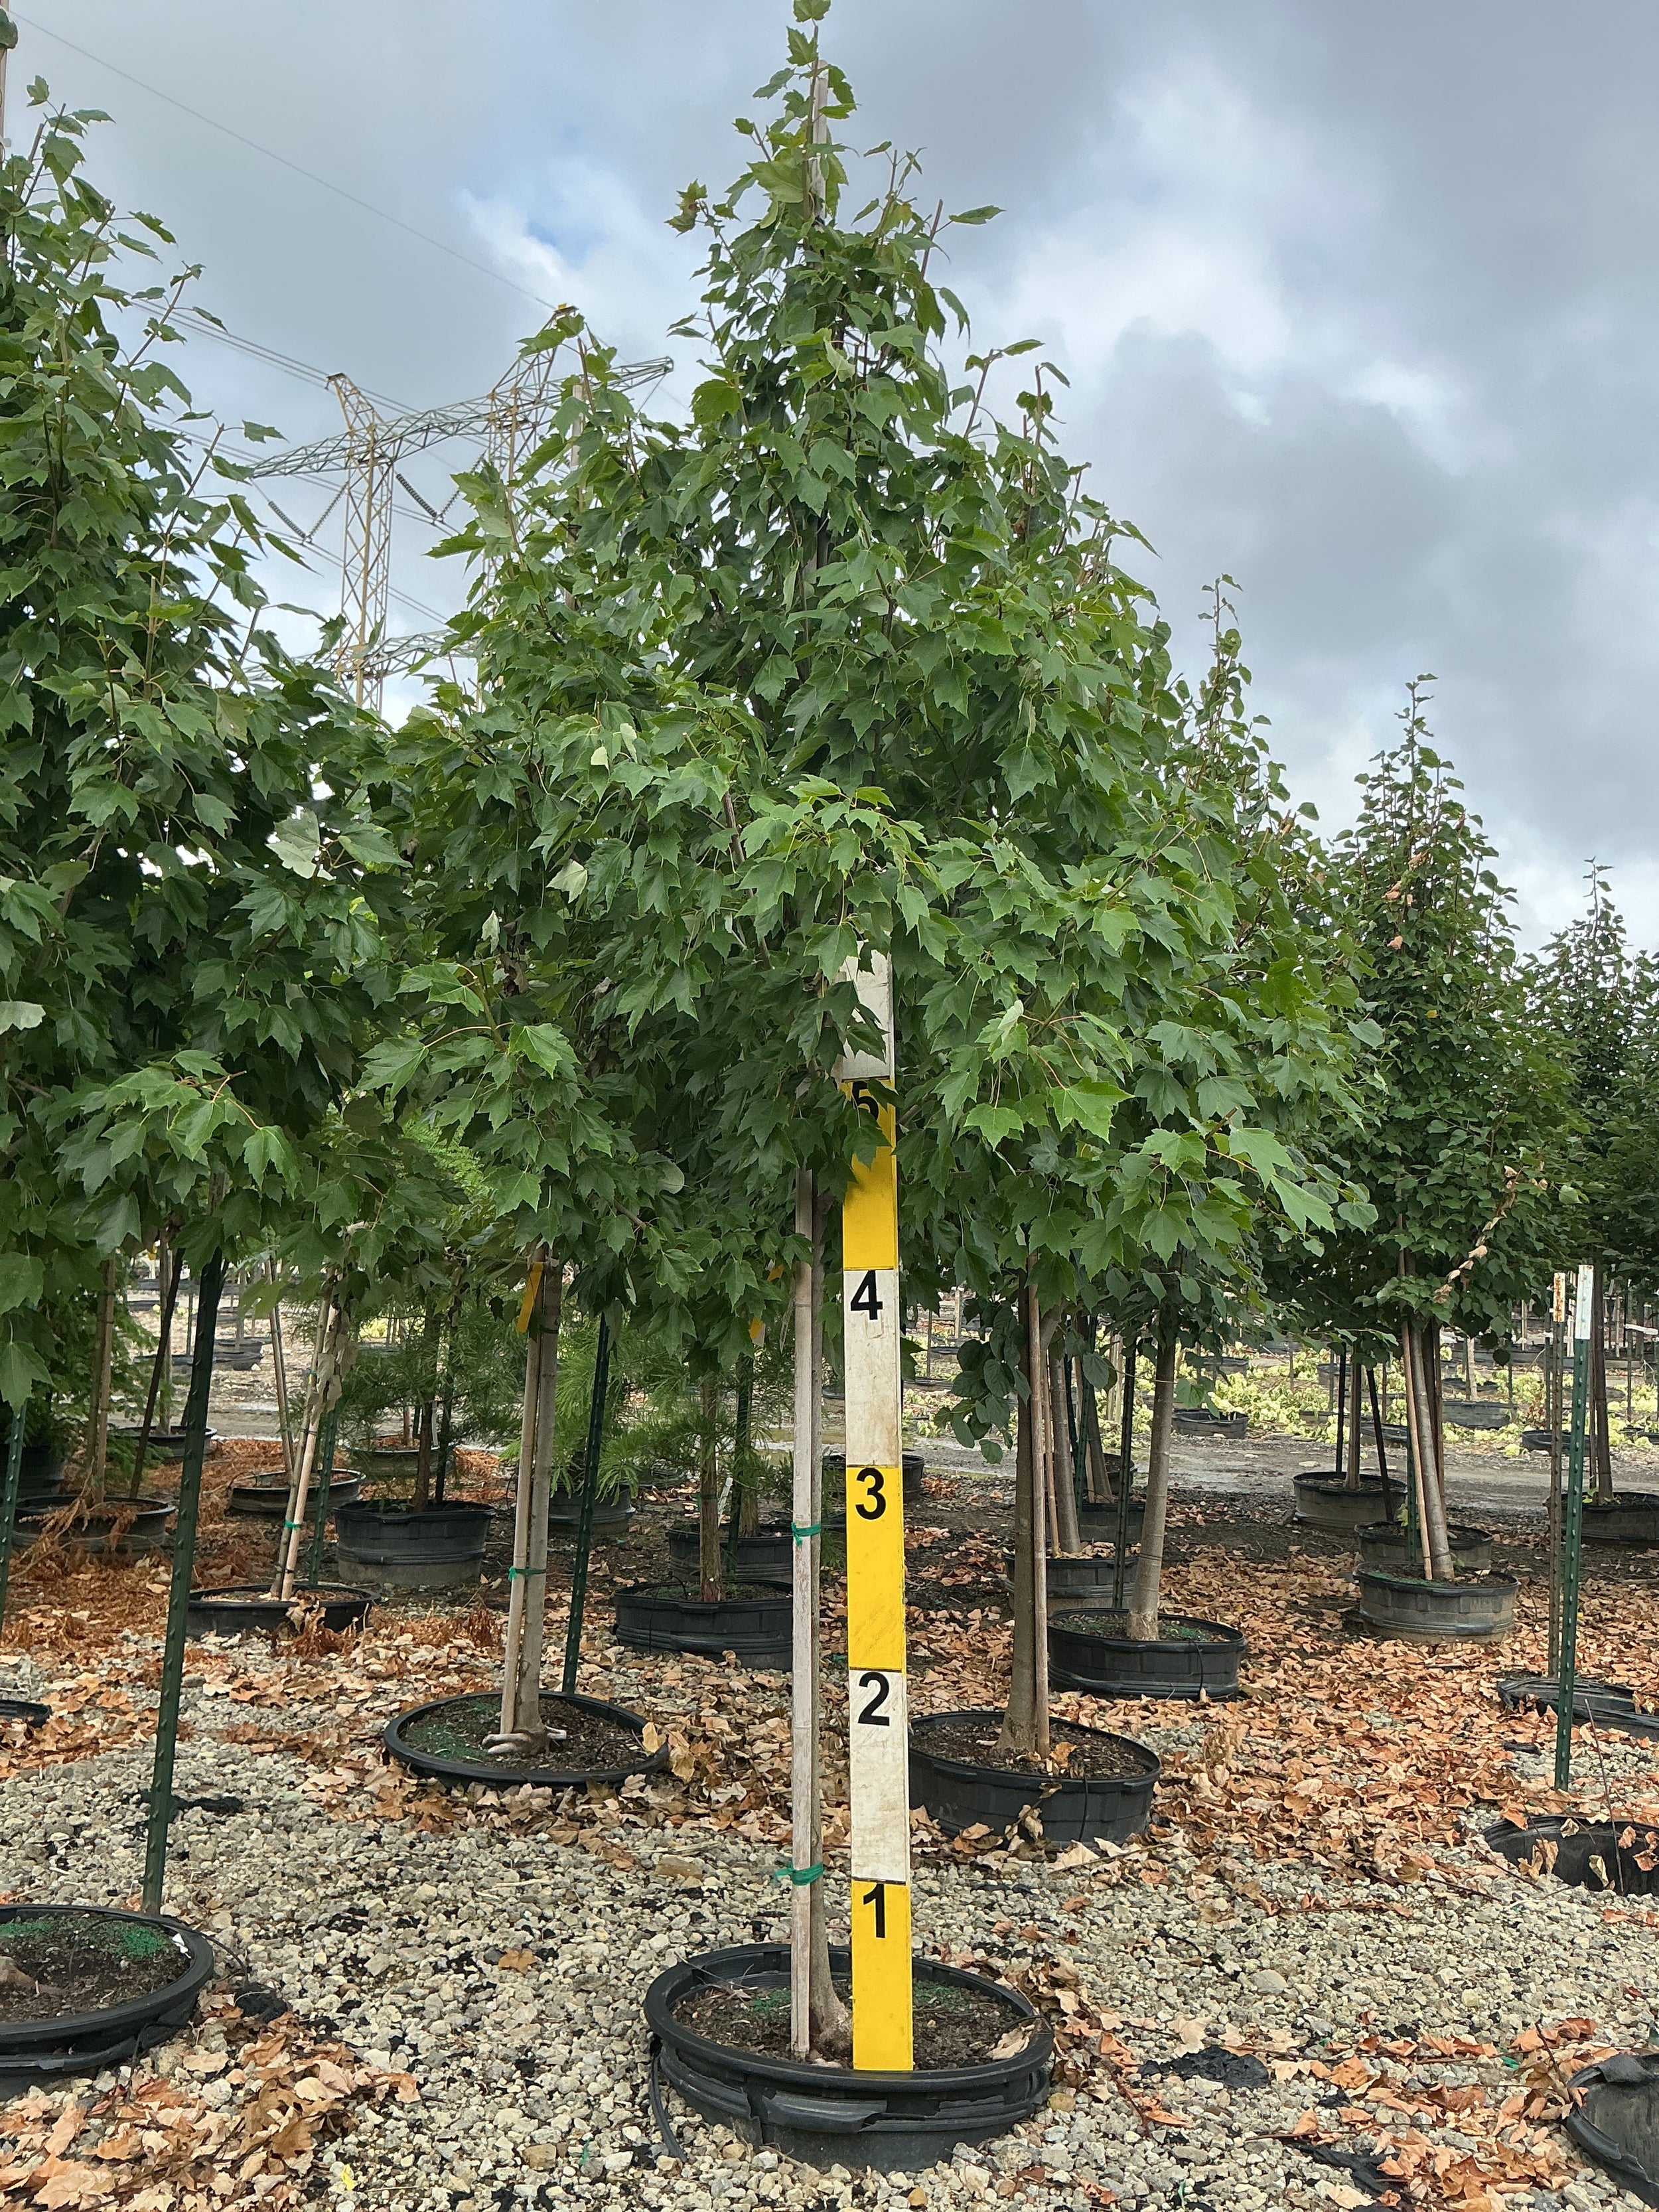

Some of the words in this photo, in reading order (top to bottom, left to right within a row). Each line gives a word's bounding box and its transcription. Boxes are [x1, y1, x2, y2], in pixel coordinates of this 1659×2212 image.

[852, 1080, 879, 1122] 5
[850, 1269, 883, 1321] 4
[855, 1467, 886, 1520] 3
[857, 1671, 890, 1727] 2
[862, 1883, 885, 1939] 1
